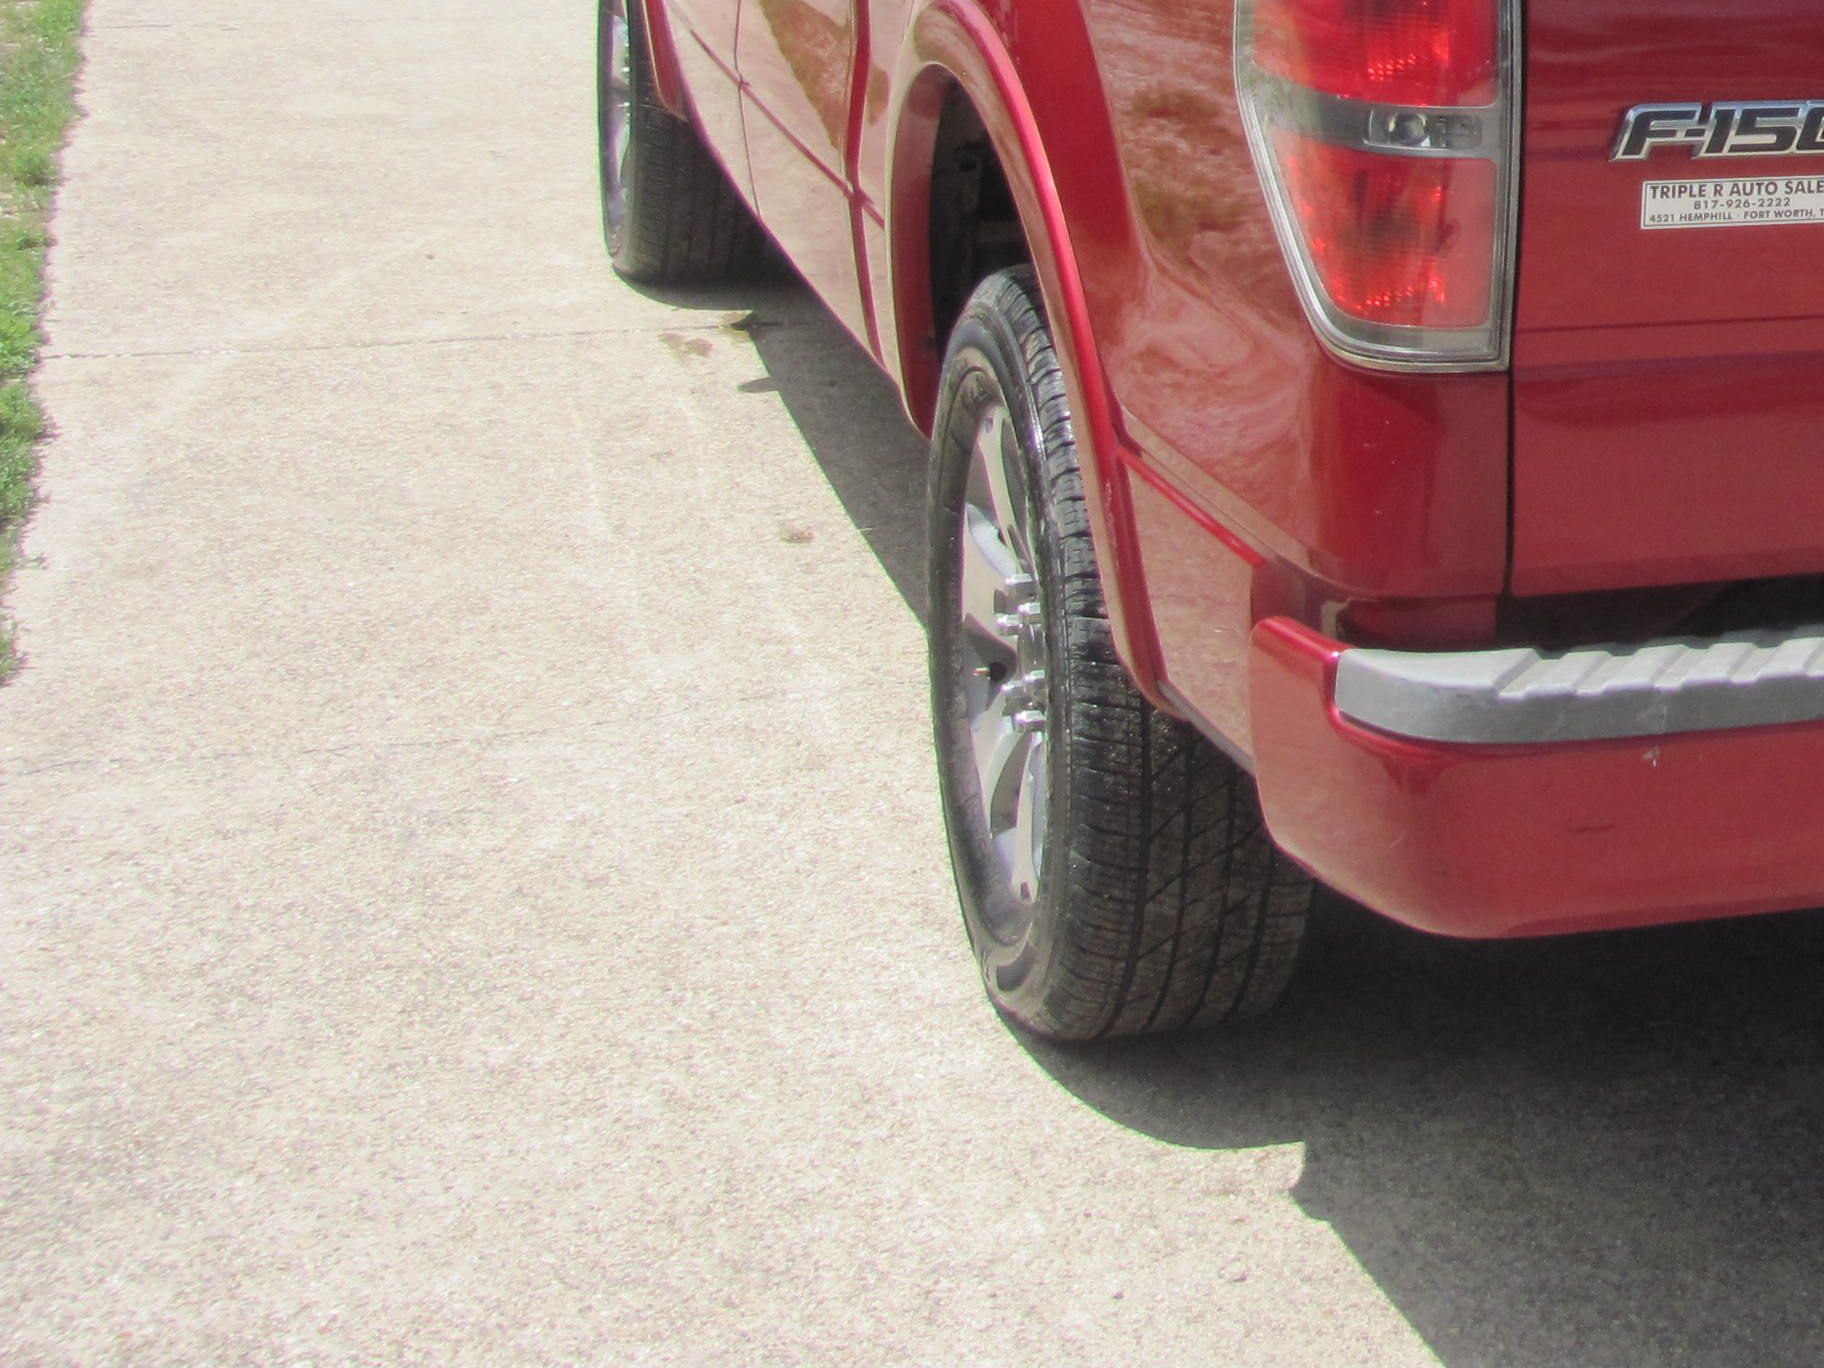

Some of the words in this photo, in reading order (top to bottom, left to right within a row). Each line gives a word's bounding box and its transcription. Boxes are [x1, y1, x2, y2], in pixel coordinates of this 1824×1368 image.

[1649, 183, 1707, 200] TRIPLE
[1713, 183, 1725, 198] R
[1728, 181, 1779, 197] AUTO
[1693, 197, 1791, 210] 817-926-2222
[1649, 213, 1675, 223] 4521
[1679, 211, 1733, 222] HEMPHILL
[1743, 210, 1771, 220] FORT
[1773, 208, 1816, 219] WORTH,
